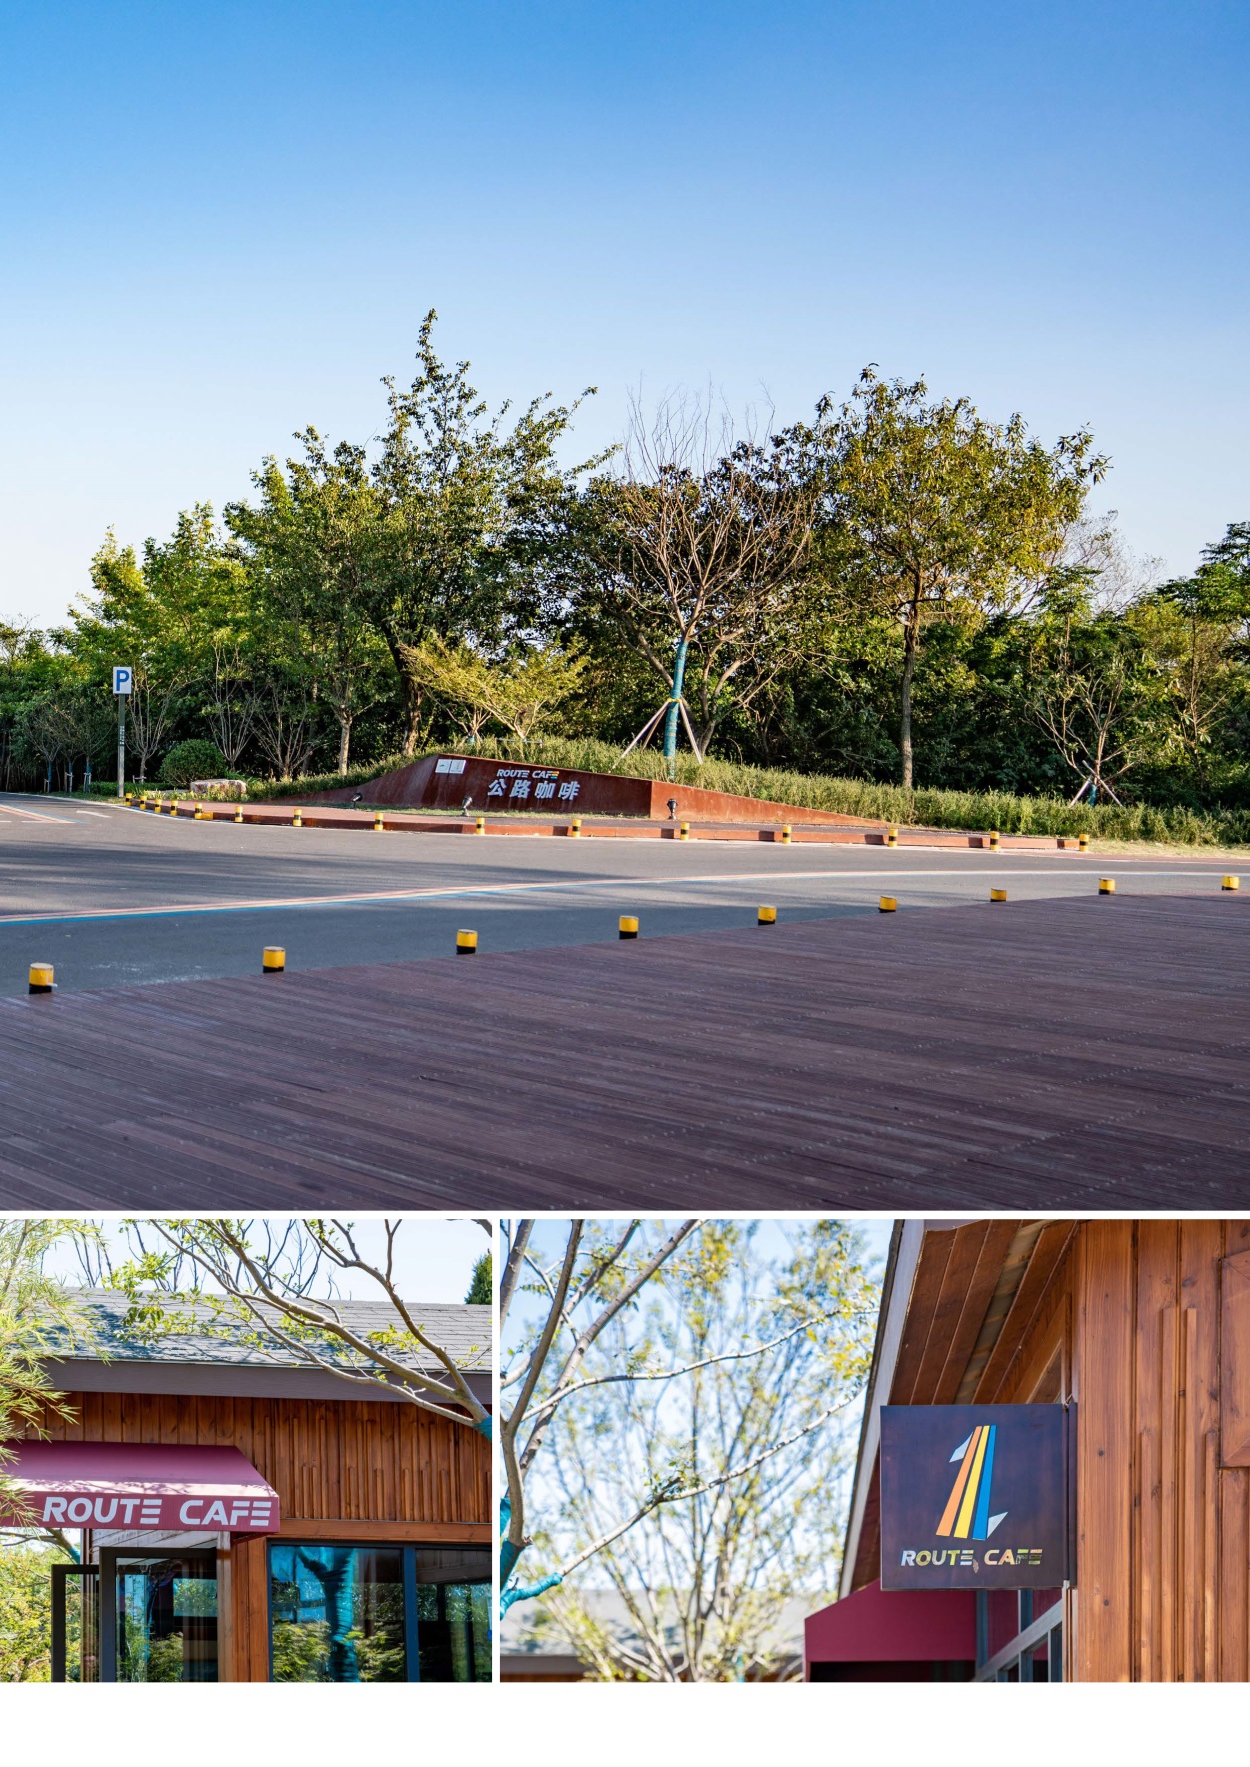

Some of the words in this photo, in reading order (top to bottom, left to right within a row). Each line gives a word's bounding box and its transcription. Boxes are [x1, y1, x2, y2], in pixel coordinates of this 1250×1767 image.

[116, 670, 130, 691] P
[496, 769, 530, 779] ROUTE
[532, 770, 559, 780] CAFE
[487, 779, 581, 801] 公路咖啡
[42, 1496, 162, 1525] ROUTE
[179, 1500, 272, 1527] CAFE
[900, 1549, 974, 1566] ROUTE
[984, 1549, 1043, 1566] CAFE
